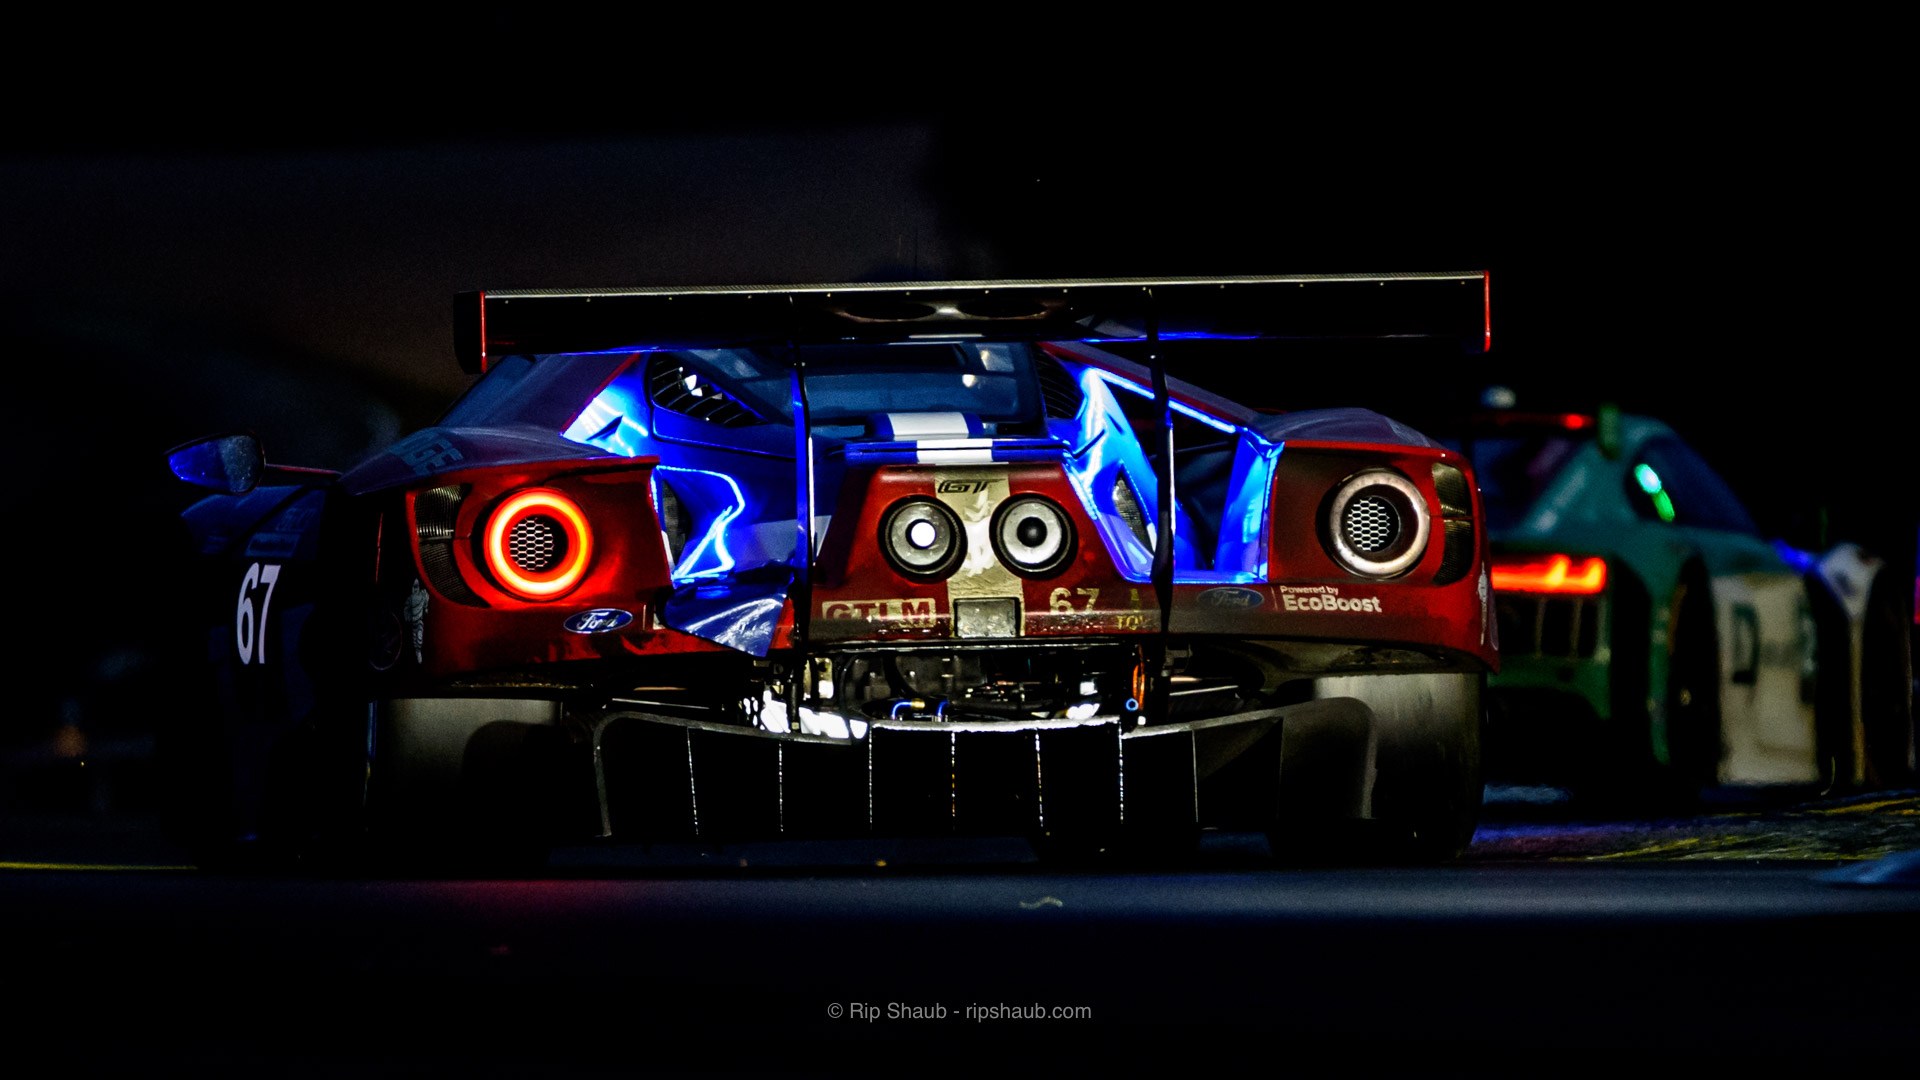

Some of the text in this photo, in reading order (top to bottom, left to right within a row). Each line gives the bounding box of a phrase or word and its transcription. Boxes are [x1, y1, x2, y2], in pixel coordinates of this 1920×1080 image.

[1049, 587, 1099, 615] 67
[1279, 585, 1339, 596] Powered by
[236, 562, 281, 666] 67
[1282, 594, 1382, 613] EcoBoost
